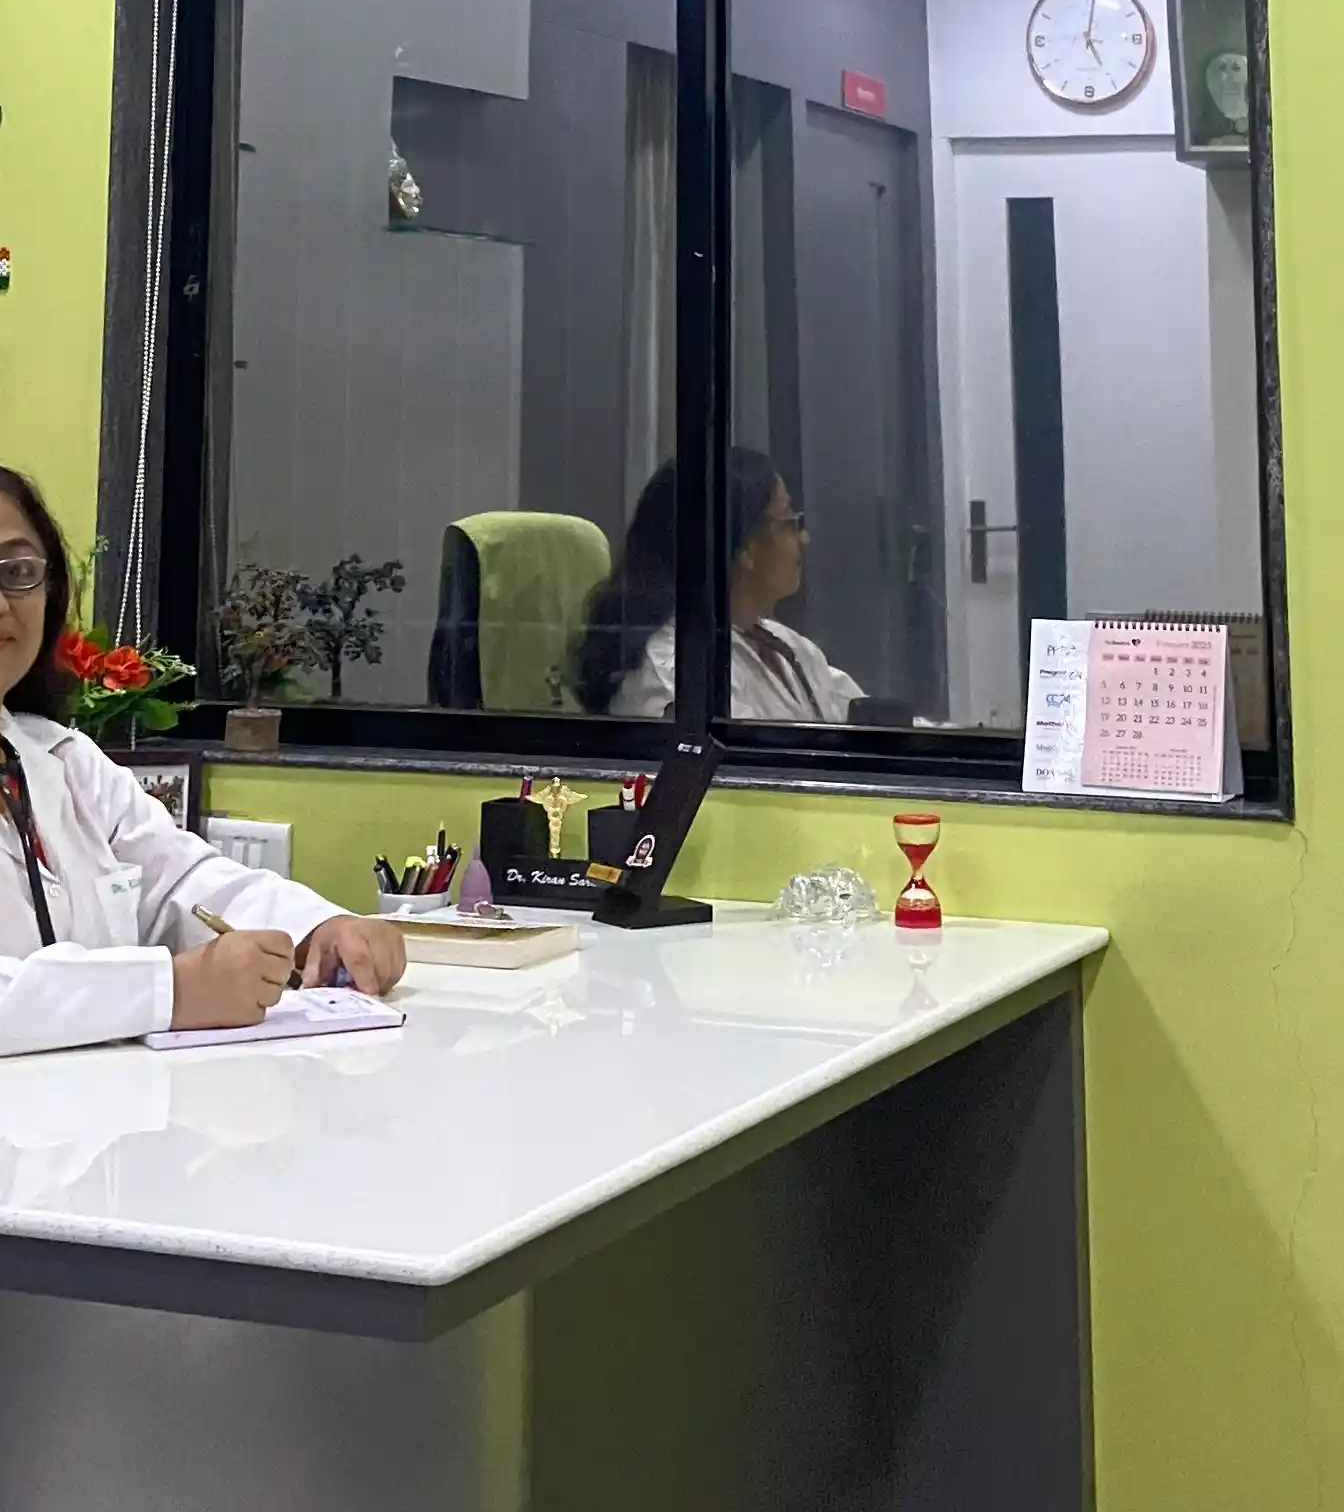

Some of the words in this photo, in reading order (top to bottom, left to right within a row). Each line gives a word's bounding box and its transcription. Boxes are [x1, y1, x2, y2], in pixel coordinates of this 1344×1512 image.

[1168, 668, 1176, 677] 2
[1184, 669, 1192, 678] 3
[1119, 681, 1126, 690] 6
[1135, 682, 1143, 691] 7
[1183, 684, 1193, 694] 10
[1199, 685, 1207, 694] 11
[1117, 697, 1128, 706] 13
[1133, 698, 1144, 707] 14
[1150, 699, 1160, 708] 15
[1166, 700, 1177, 709] 16
[1182, 701, 1193, 710] 17
[1115, 713, 1128, 722] 20
[1132, 714, 1143, 723] 21
[1148, 715, 1161, 724] 22
[1164, 716, 1176, 725] 23
[1179, 717, 1193, 726] 24
[1196, 718, 1208, 727] 25
[1115, 729, 1128, 738] 27
[531, 870, 566, 886] Kiran
